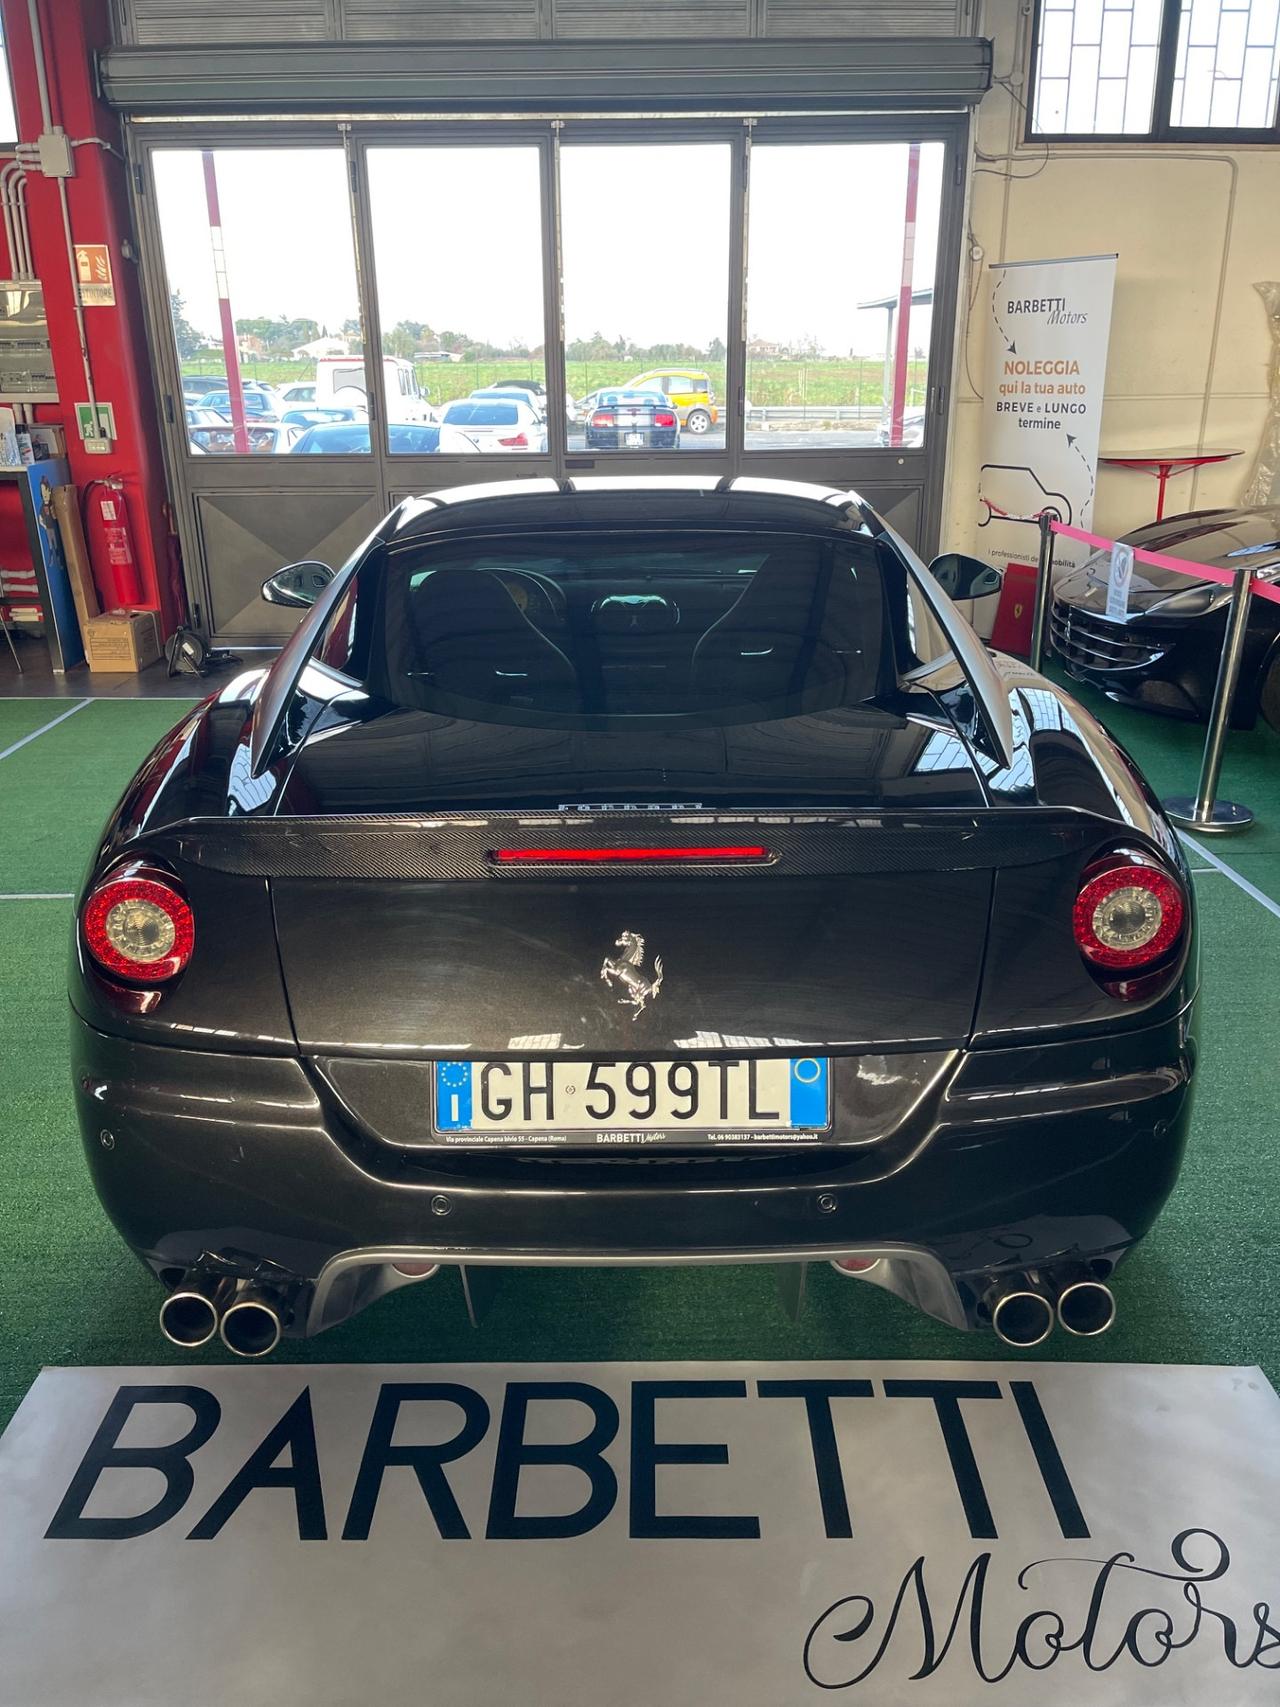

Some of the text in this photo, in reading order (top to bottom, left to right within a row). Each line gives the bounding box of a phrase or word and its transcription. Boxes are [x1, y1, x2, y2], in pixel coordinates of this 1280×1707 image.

[1007, 298, 1065, 314] BARBETTI
[1047, 310, 1088, 325] Motors
[1004, 360, 1080, 375] NOLEGGIA
[999, 381, 1086, 396] qui la tua auto
[996, 402, 1034, 412] BREVE
[1045, 403, 1087, 414] LUNGO
[1018, 417, 1061, 429] termine
[481, 1061, 554, 1121] GH
[454, 1136, 483, 1144] provinciale
[596, 1133, 645, 1143] BARBETTI
[44, 1380, 1091, 1541] BARBETTI
[803, 1528, 1280, 1690] Motors
